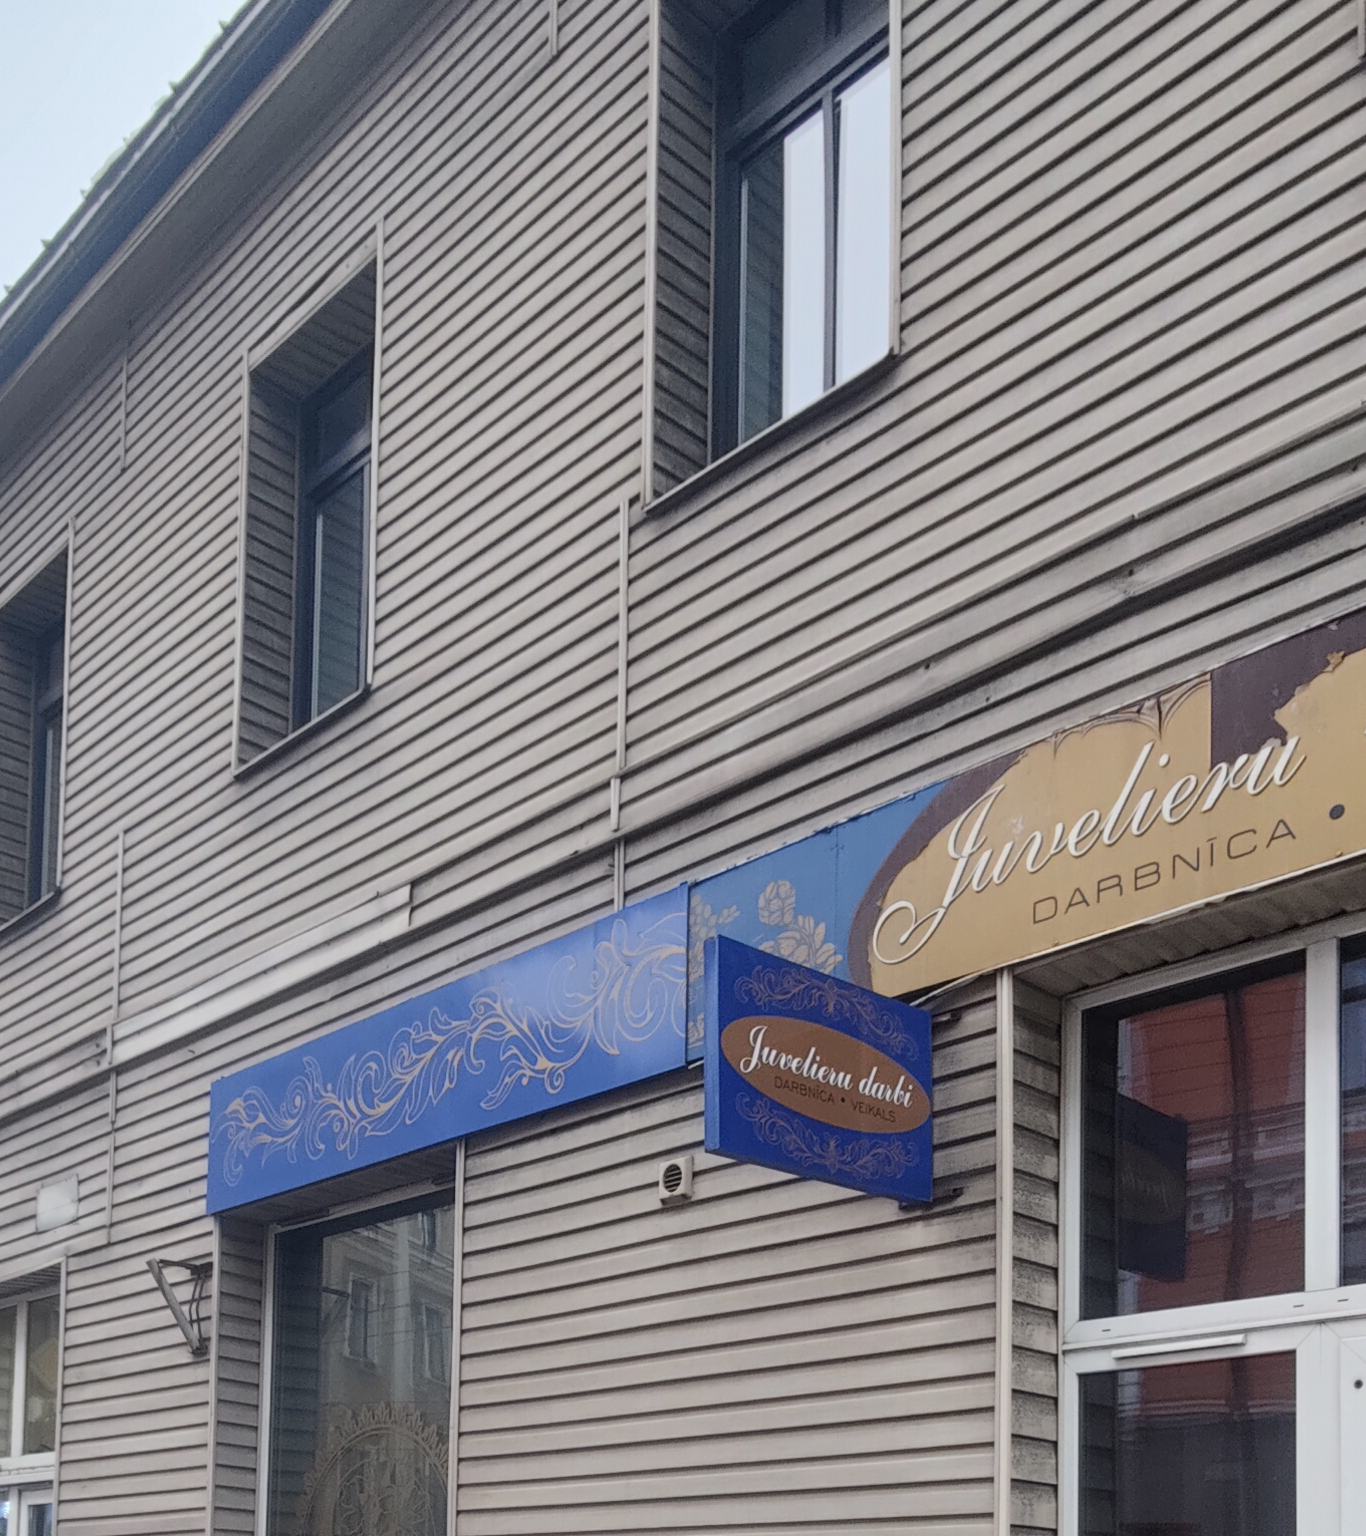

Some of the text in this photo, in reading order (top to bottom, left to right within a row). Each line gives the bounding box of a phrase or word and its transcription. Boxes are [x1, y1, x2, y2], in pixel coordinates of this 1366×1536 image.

[873, 736, 1307, 965] Juvelieru
[1032, 819, 1297, 925] DARBNĪCA
[739, 1025, 913, 1109] Juvelieru darbi
[774, 1076, 896, 1123] DARBNĪCA VEIKALS
